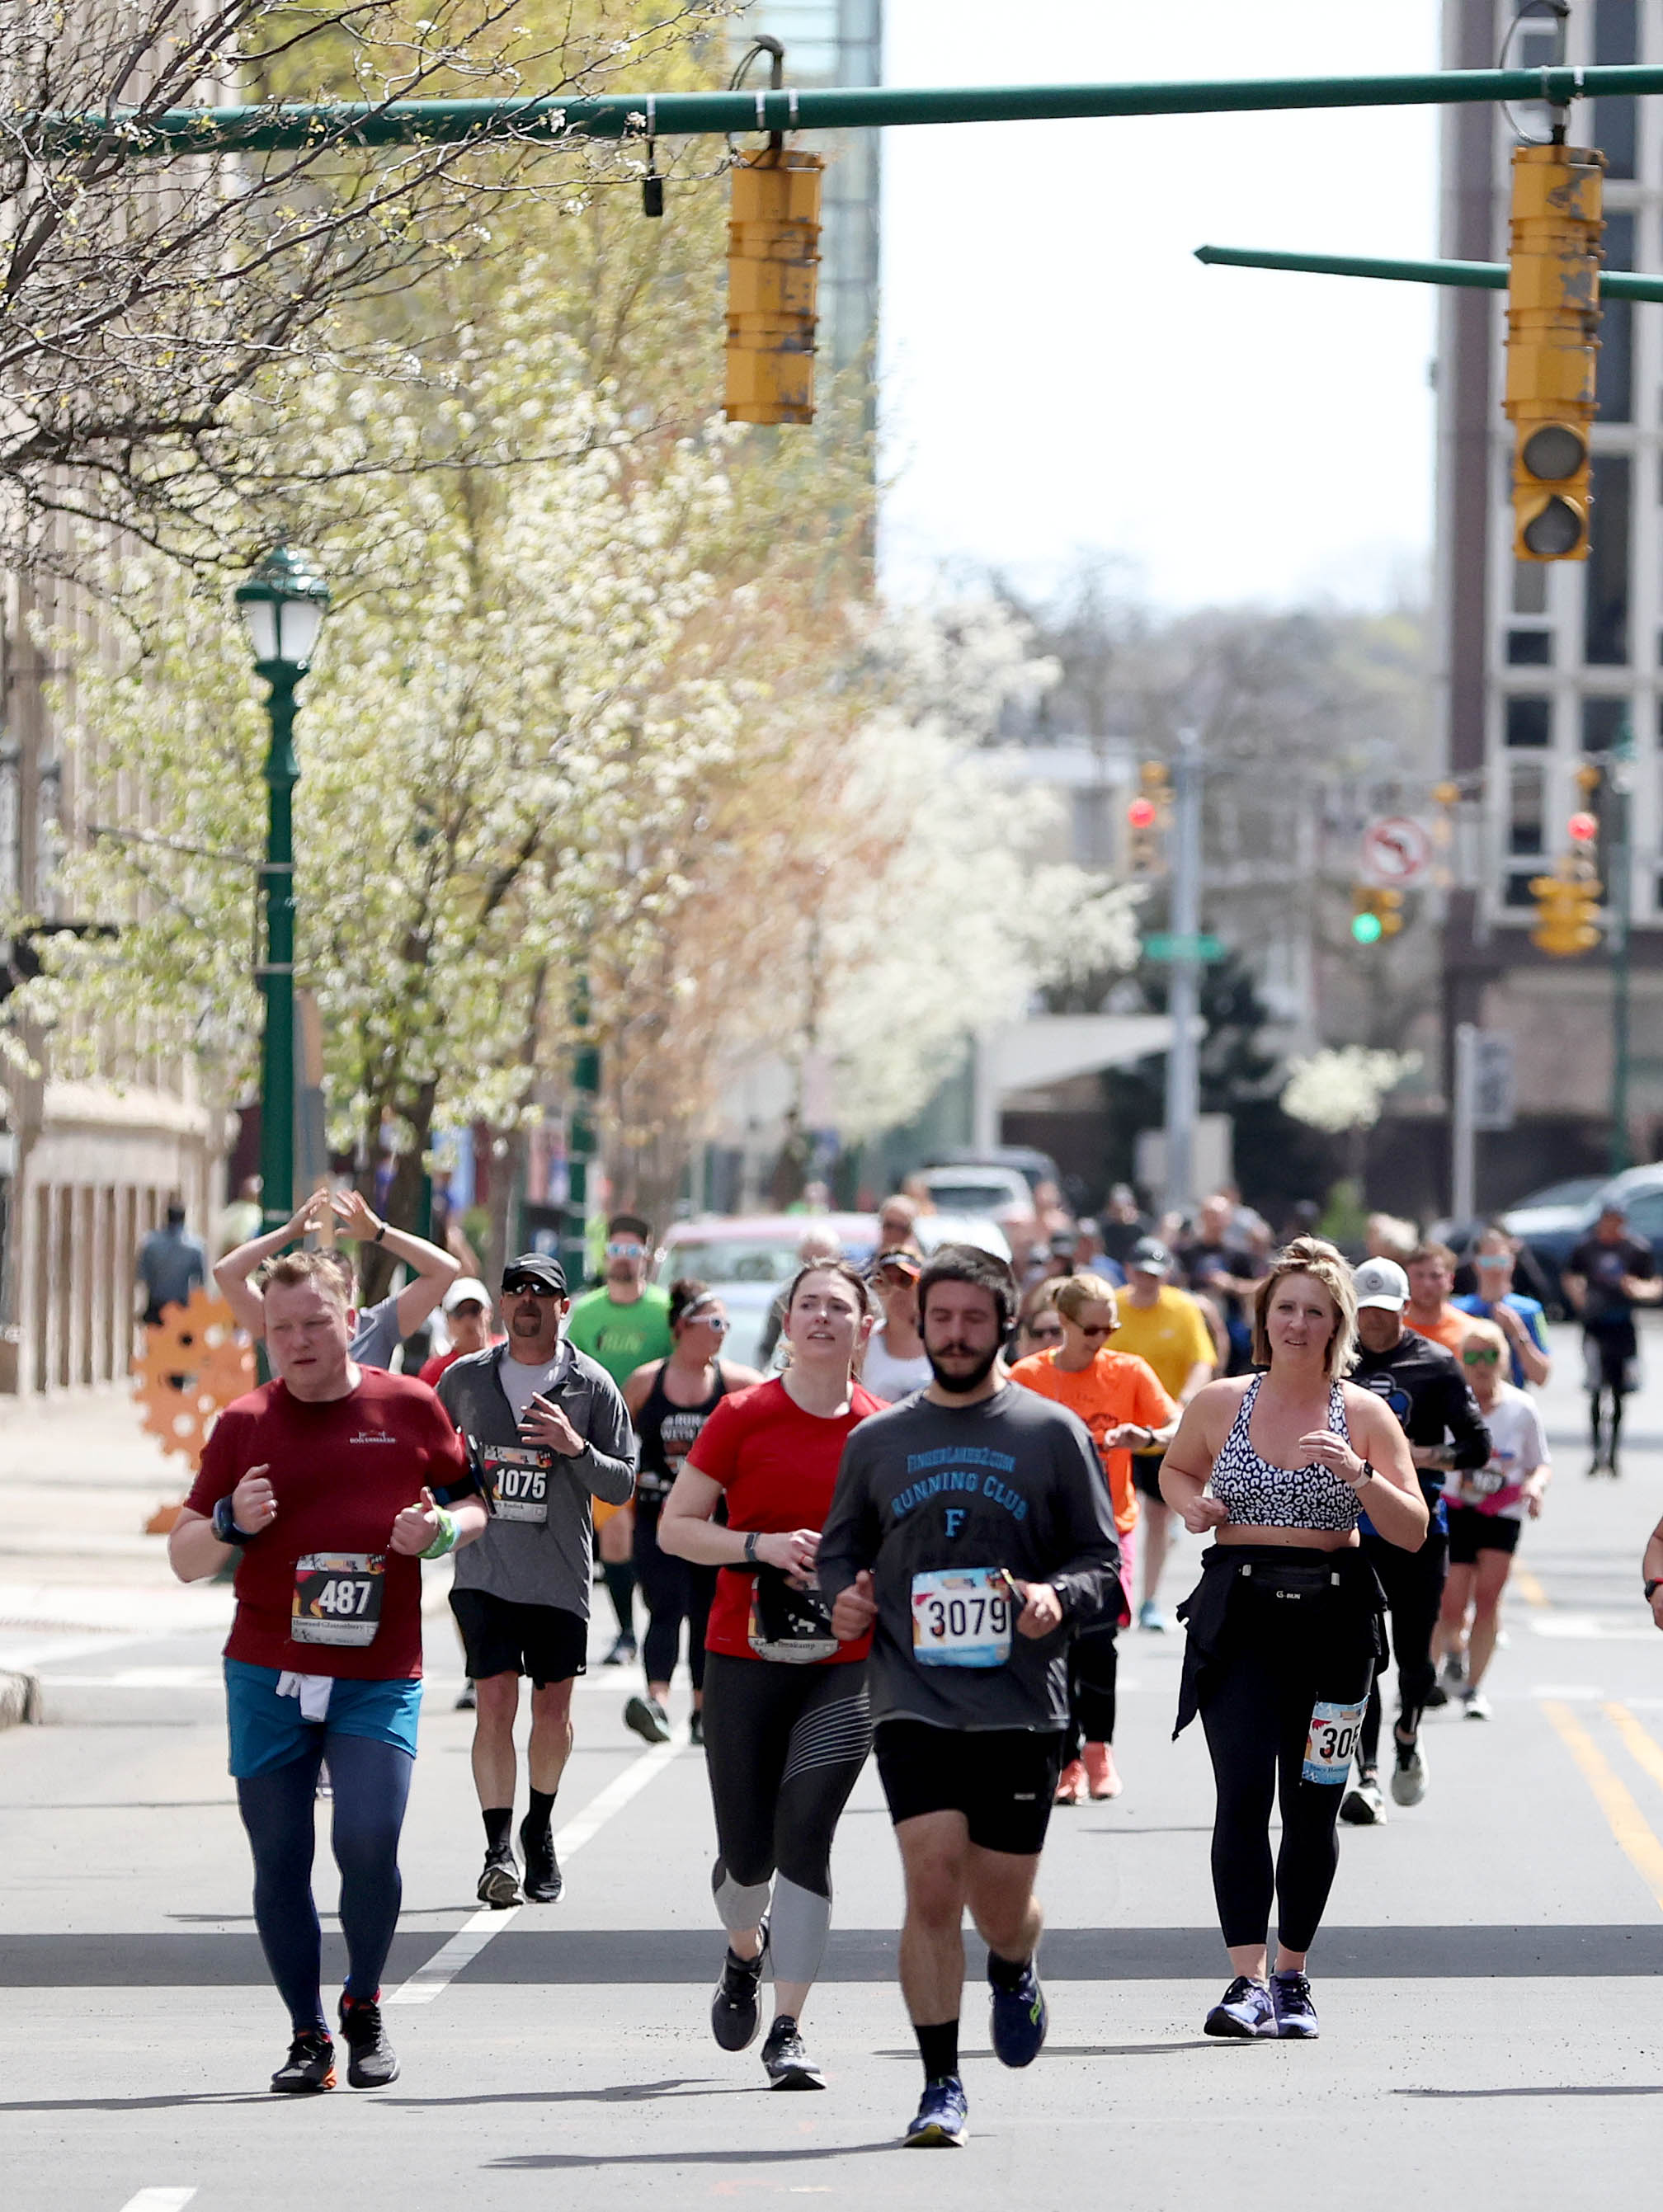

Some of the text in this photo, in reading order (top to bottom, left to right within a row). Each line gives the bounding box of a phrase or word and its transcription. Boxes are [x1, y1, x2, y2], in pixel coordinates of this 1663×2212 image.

[496, 1468, 547, 1499] 1075
[891, 1471, 1029, 1521] RUNNING CLUB
[945, 1508, 967, 1537] F
[318, 1579, 372, 1615] 487
[929, 1598, 1006, 1637] 3079
